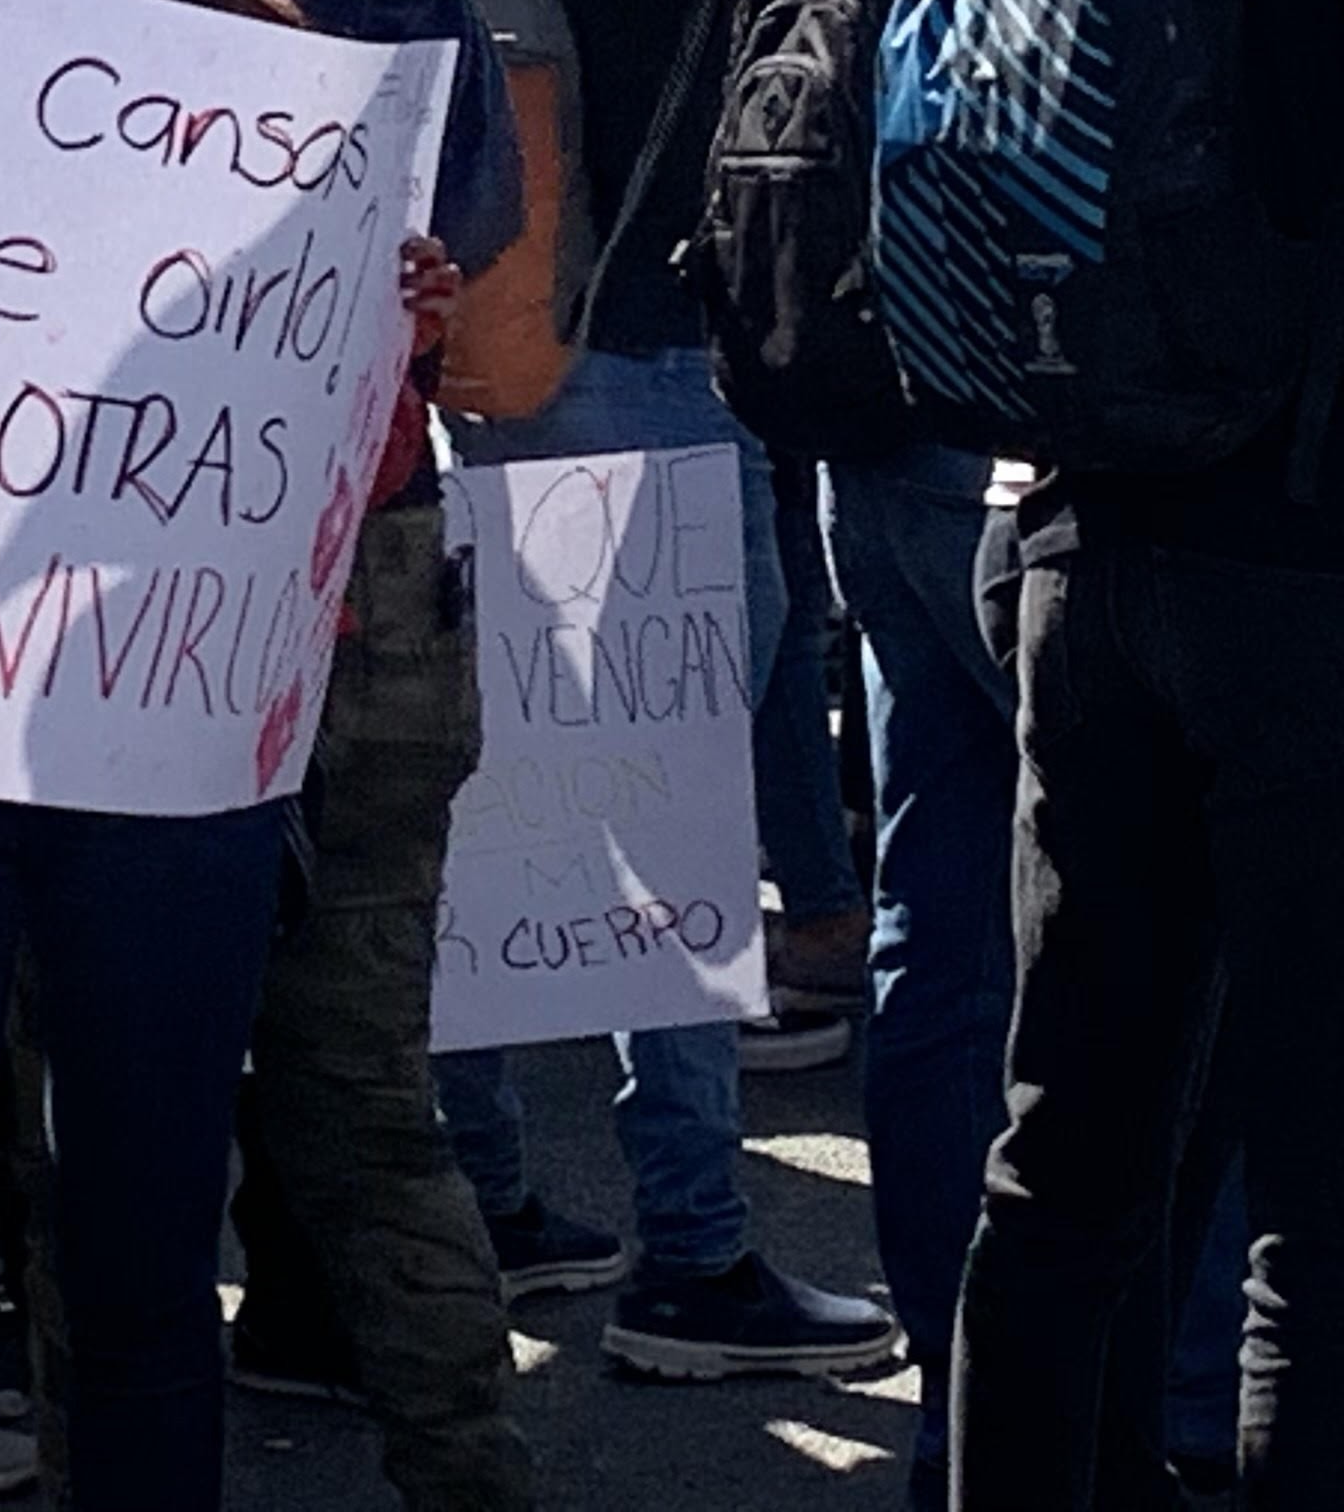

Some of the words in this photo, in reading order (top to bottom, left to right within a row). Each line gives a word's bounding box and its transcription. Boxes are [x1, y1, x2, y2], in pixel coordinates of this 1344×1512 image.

[518, 448, 736, 605] QUE
[498, 610, 754, 727] VENGAN
[501, 898, 724, 971] CUERPO
